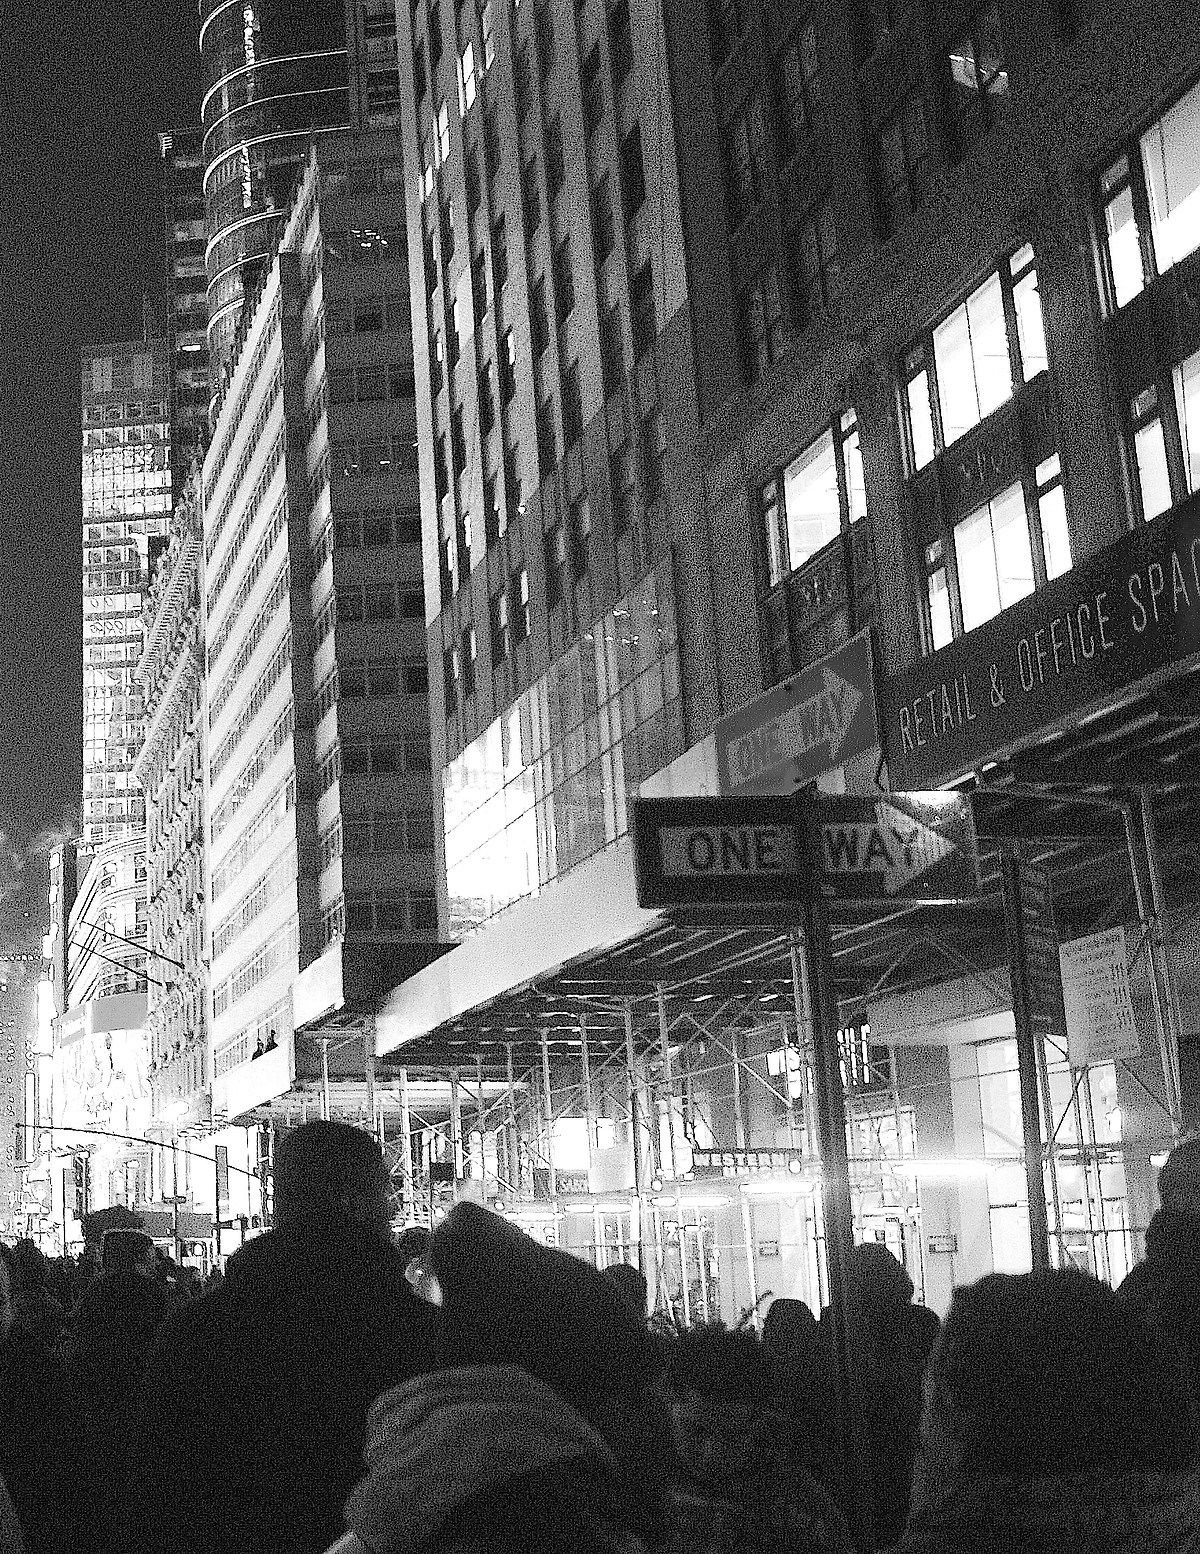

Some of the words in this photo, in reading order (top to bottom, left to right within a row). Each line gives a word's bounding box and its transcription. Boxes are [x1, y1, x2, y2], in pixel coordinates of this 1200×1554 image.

[900, 672, 976, 753] RETAIL
[990, 664, 1006, 708] &
[1017, 592, 1114, 691] OFFICE
[737, 721, 783, 777] ONE
[799, 685, 846, 746] WAY
[686, 830, 780, 870] ONE
[825, 828, 919, 868] WAY
[693, 1153, 785, 1167] WESTERN
